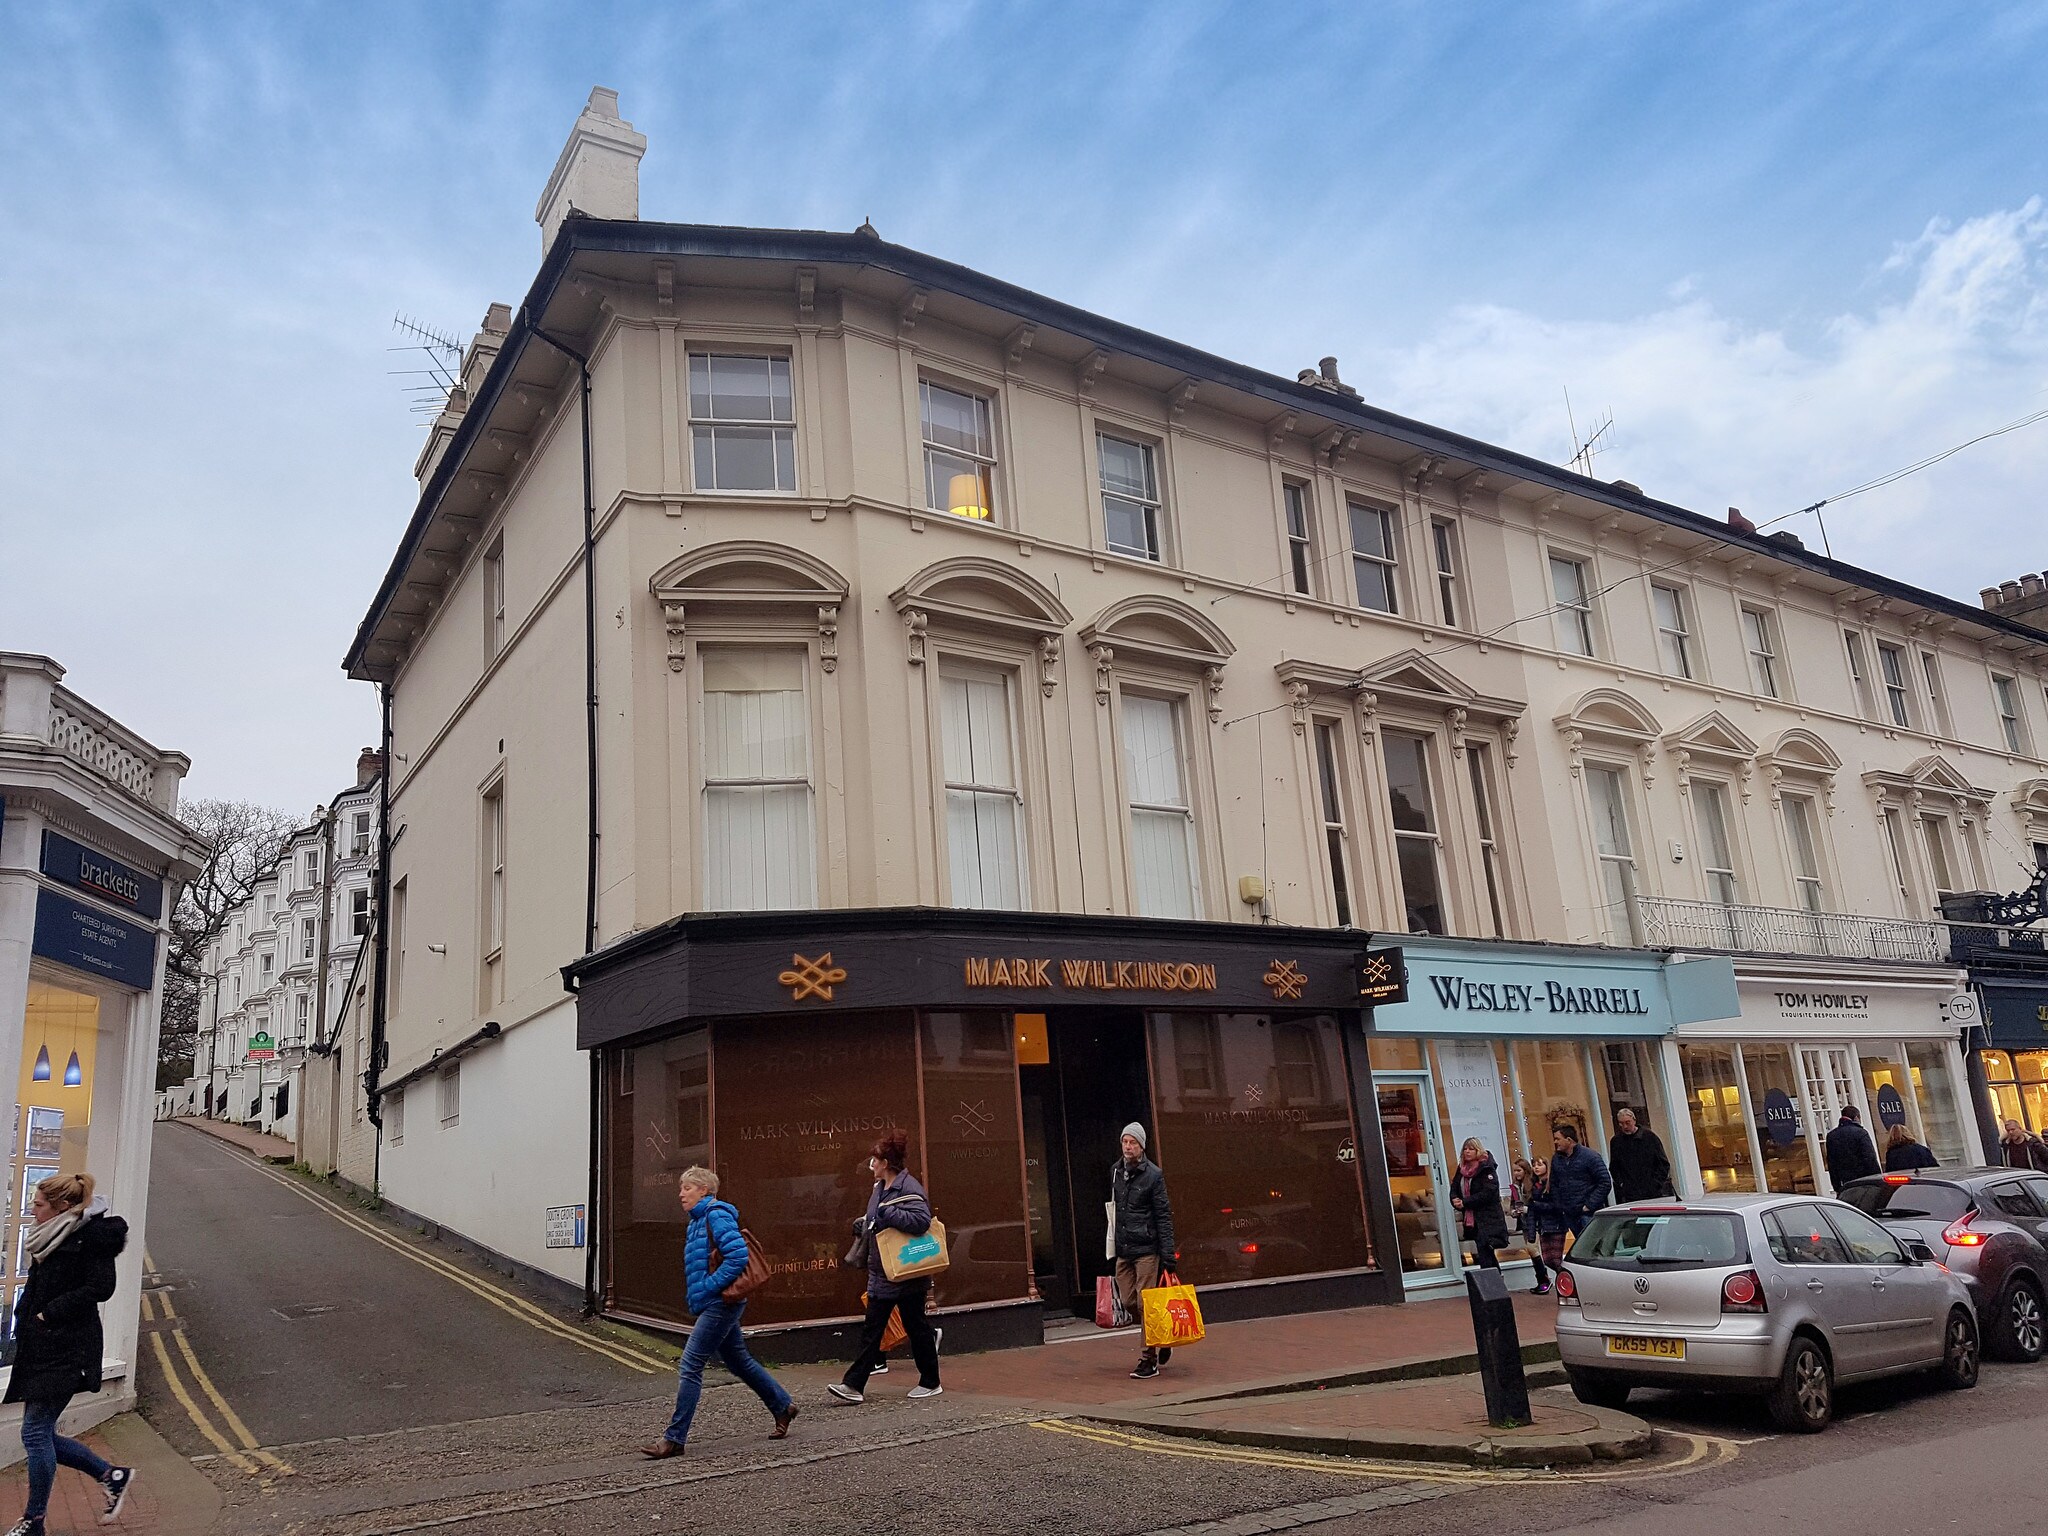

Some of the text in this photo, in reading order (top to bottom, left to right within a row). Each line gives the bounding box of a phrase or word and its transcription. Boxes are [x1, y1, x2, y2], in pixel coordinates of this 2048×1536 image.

[80, 852, 139, 901] bracketts
[72, 911, 127, 939] CHARTERED SURVEYORS
[81, 928, 117, 948] ESTATE AGENTS
[966, 957, 1218, 990] MARK WILKINSON
[1774, 992, 1869, 1009] TOM HOWLEY
[1448, 1078, 1492, 1088] SOFA SALE
[1767, 1107, 1793, 1121] SALE
[1880, 1101, 1902, 1114] SALE
[1203, 1109, 1309, 1125] MARK WILKINSON
[740, 1114, 897, 1141] MARK WILKINSON
[1396, 1128, 1415, 1138] OFF
[799, 1142, 842, 1153] ENGLAND
[560, 1208, 574, 1220] GROVE
[768, 1259, 825, 1274] URNITURE
[1614, 1336, 1677, 1355] GK59 YSA
